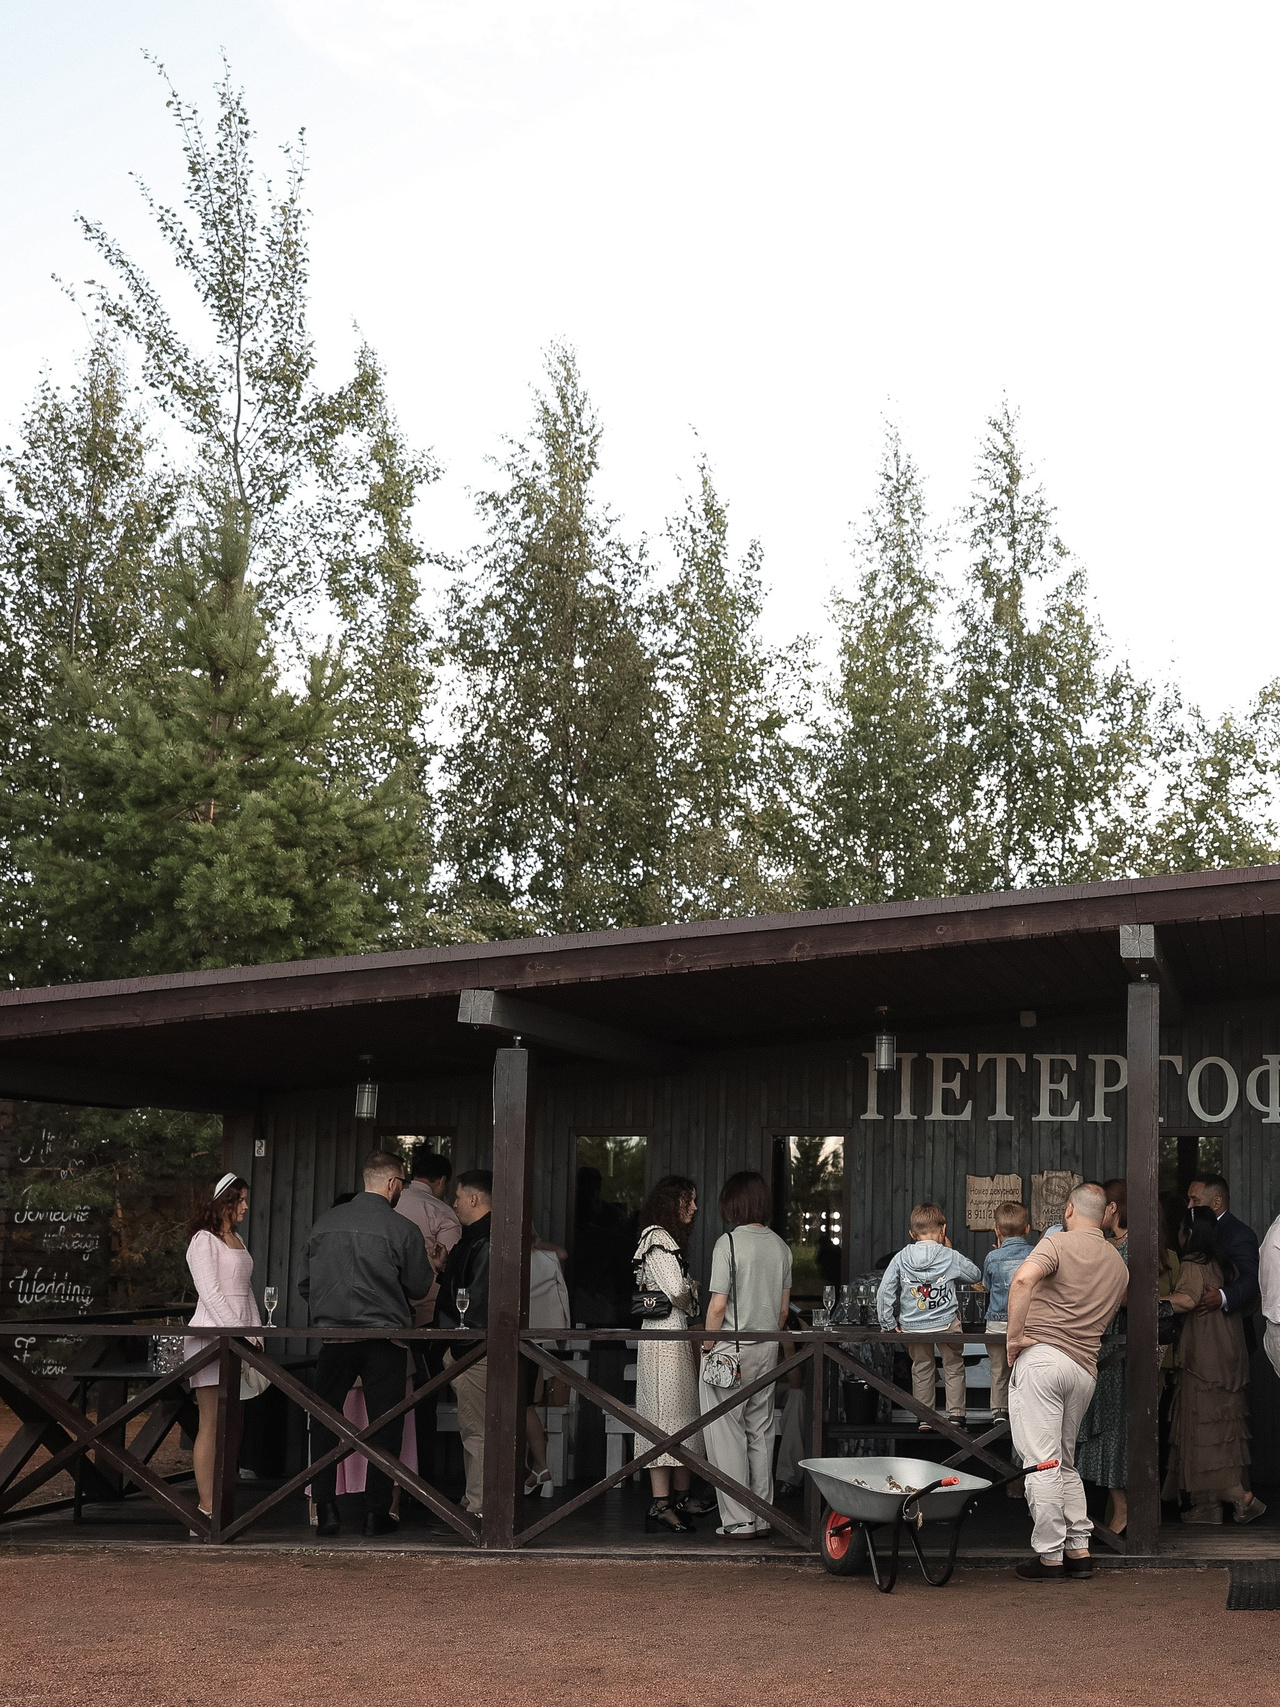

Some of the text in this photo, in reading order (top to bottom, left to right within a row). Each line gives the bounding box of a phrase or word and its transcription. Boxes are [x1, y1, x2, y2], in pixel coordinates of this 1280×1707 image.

[967, 1209, 972, 1219] 8
[974, 1209, 985, 1219] 911
[929, 1283, 947, 1300] OH
